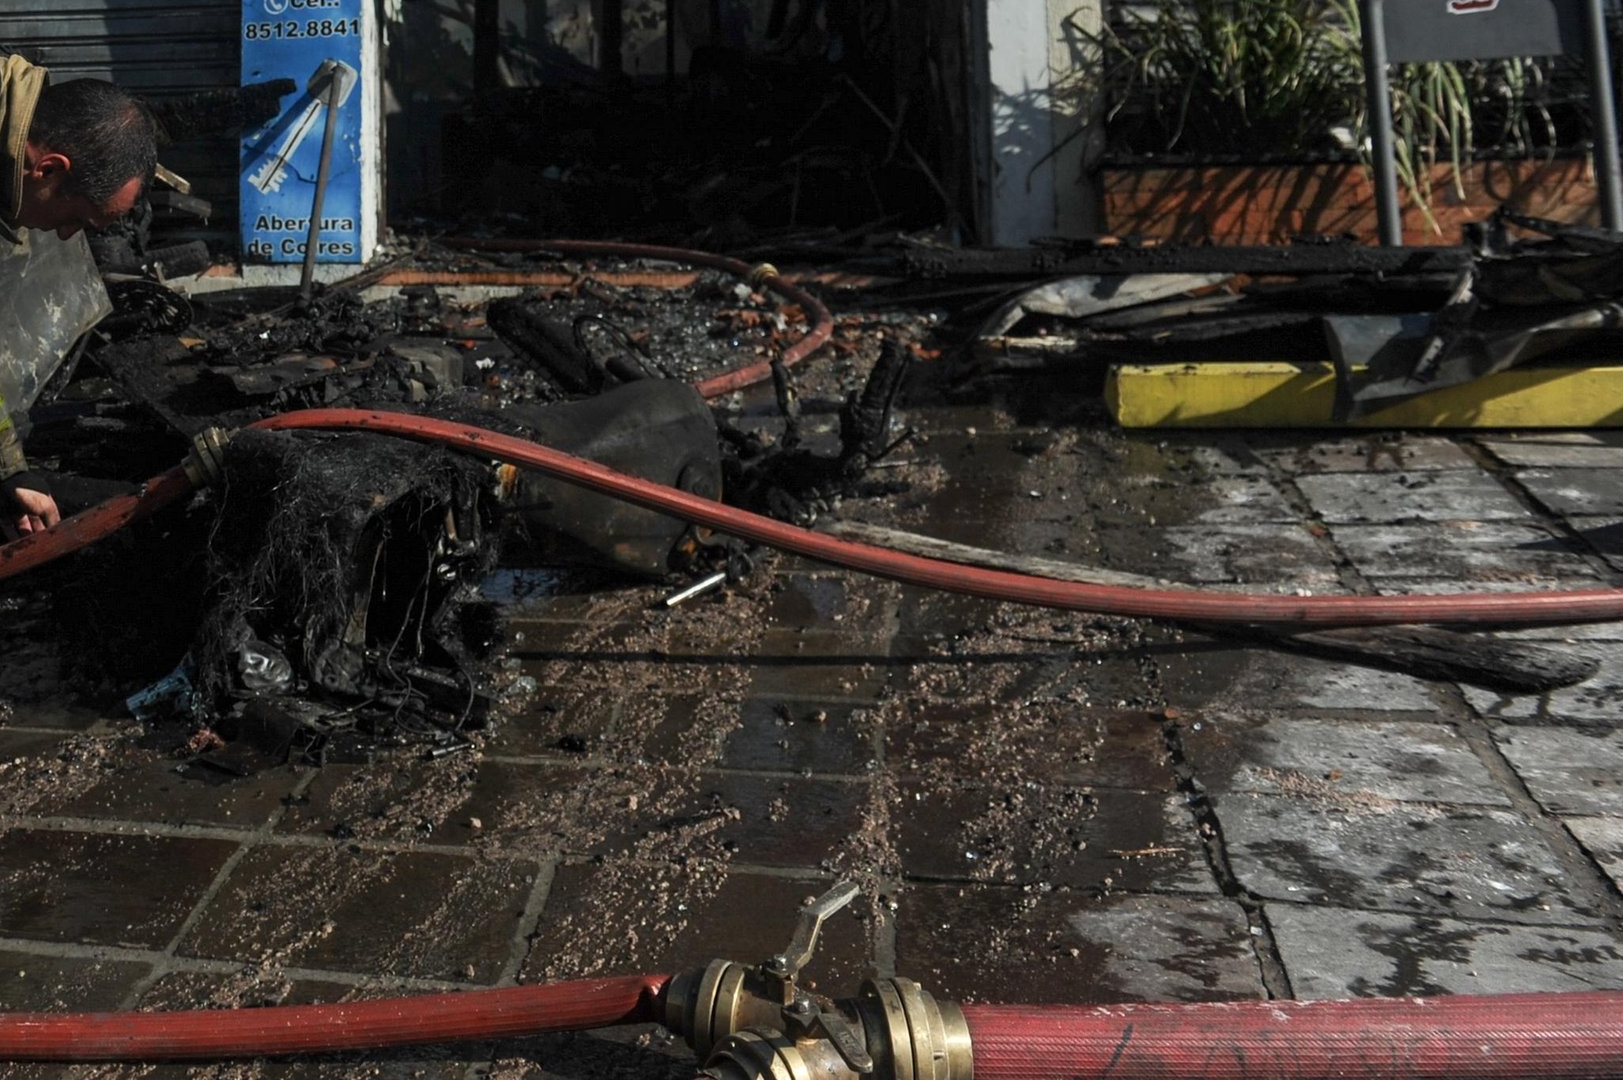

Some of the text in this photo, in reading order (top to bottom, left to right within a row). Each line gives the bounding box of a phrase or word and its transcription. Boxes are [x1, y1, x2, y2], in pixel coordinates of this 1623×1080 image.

[244, 18, 360, 41] 8512.8841
[255, 214, 354, 232] Aberura
[248, 238, 354, 256] de Cores
